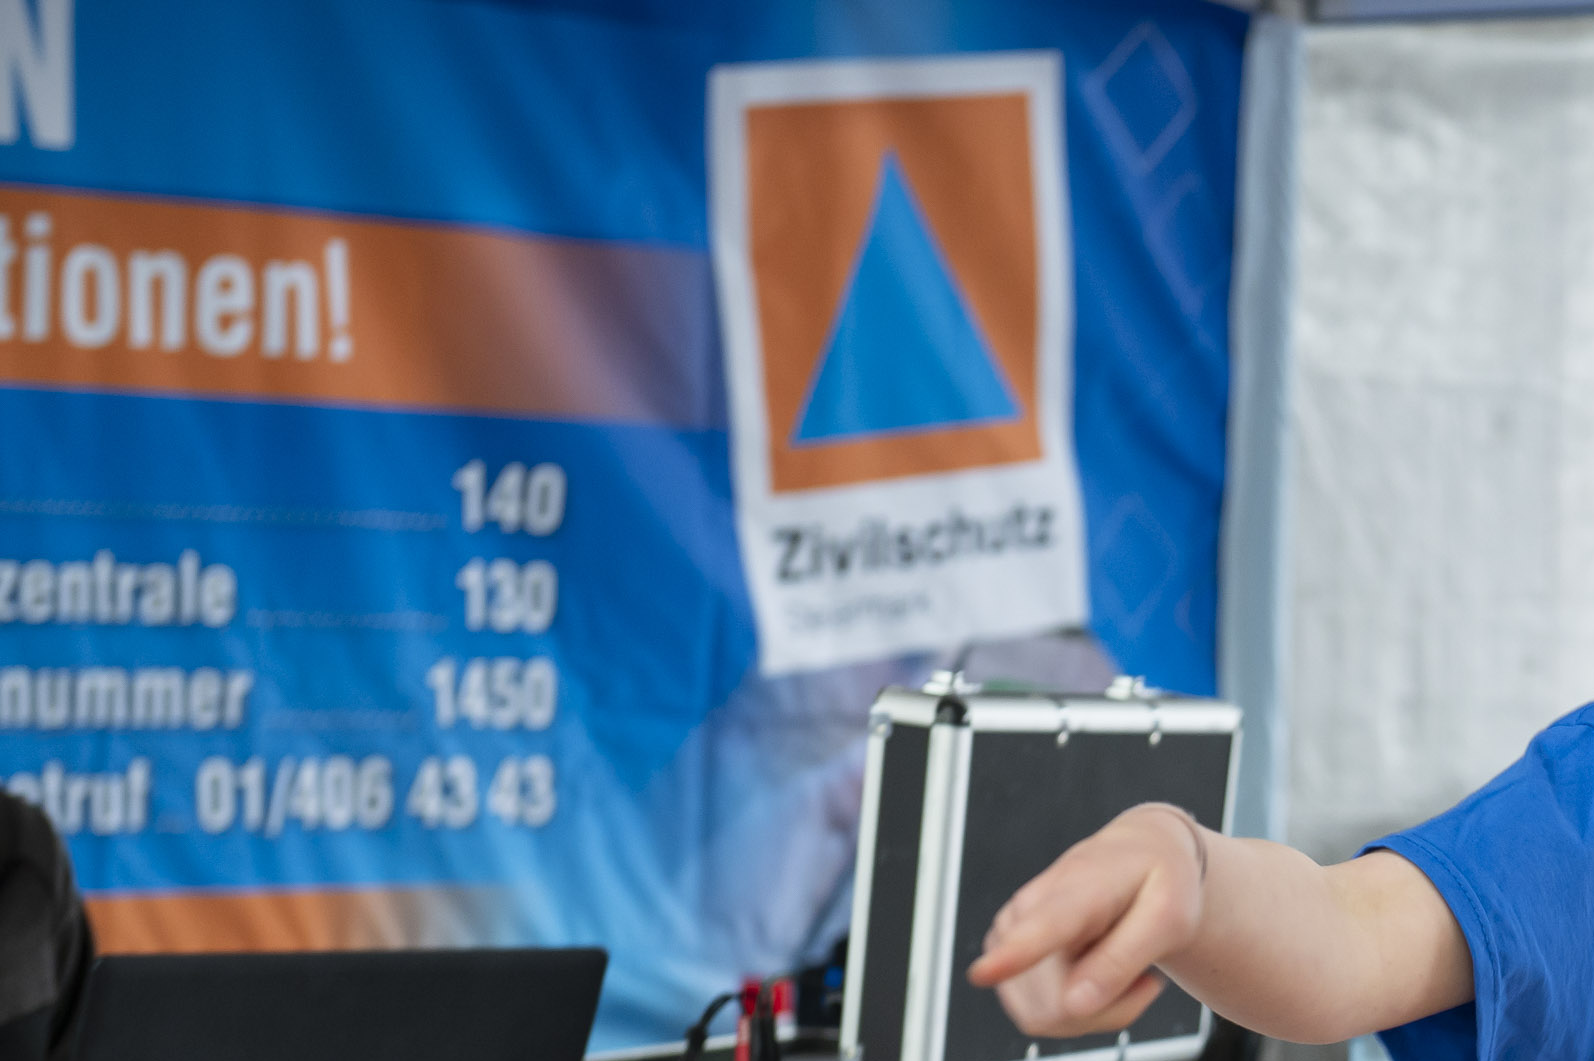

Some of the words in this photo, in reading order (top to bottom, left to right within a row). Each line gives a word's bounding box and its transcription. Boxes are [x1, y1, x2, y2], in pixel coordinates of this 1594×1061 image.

[450, 459, 567, 535] 140
[772, 503, 1056, 584] Zivilschutz
[455, 557, 558, 633] 130
[0, 666, 254, 731] nummer
[426, 657, 559, 730] 1450
[196, 756, 394, 838] 01/406
[408, 756, 479, 829] 43
[489, 755, 556, 828] 43
